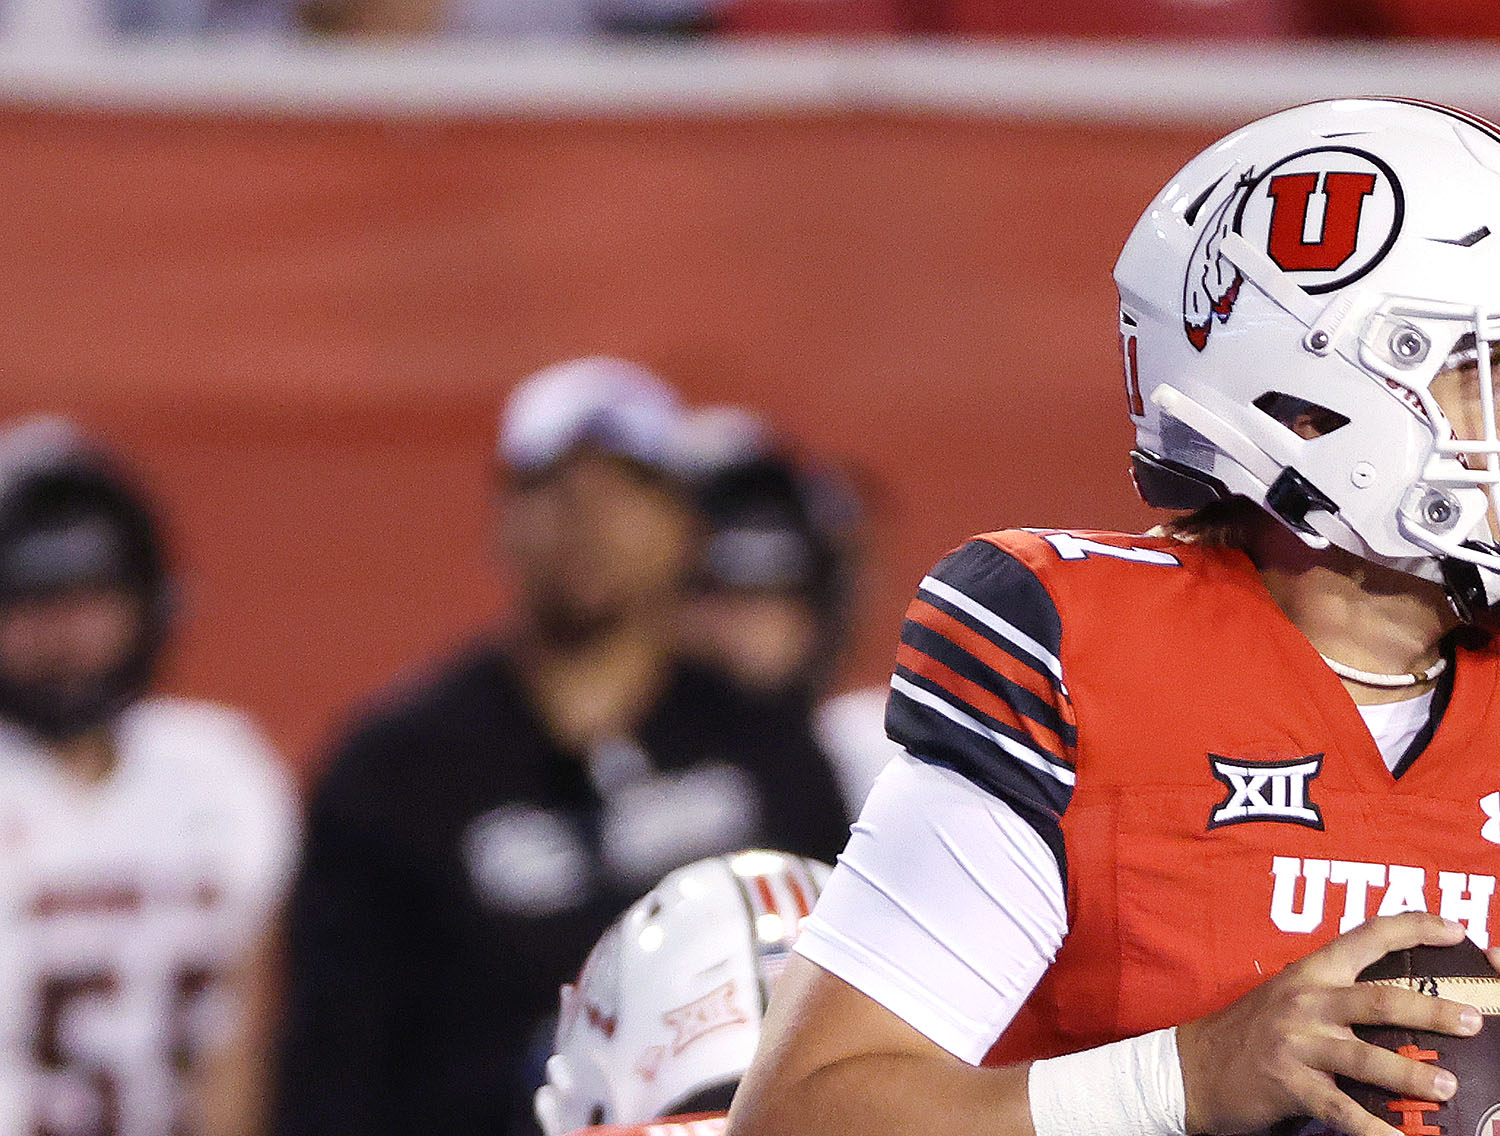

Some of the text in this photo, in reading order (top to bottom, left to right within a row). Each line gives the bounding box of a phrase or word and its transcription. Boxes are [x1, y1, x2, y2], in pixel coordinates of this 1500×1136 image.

[1266, 171, 1377, 272] U
[1209, 755, 1324, 830] XII
[1270, 856, 1497, 950] UTAH
